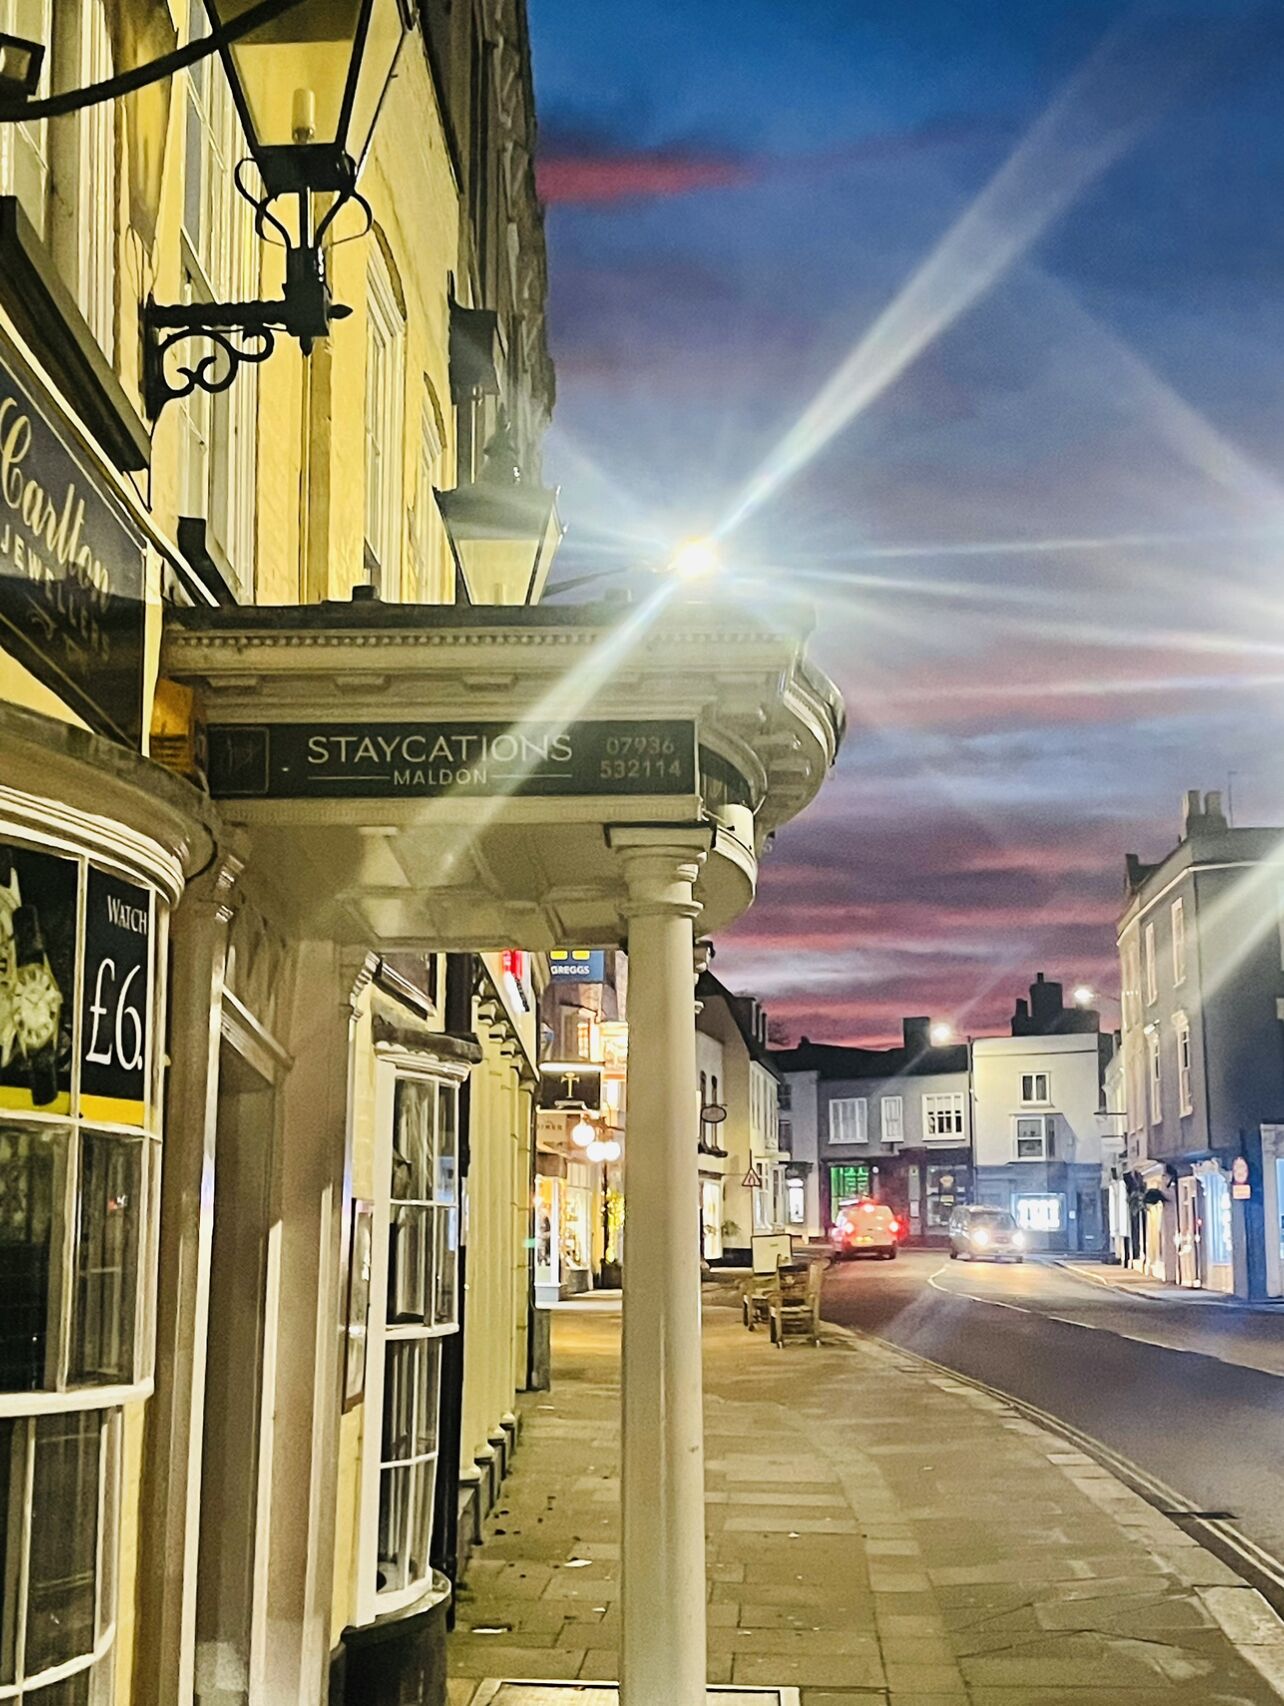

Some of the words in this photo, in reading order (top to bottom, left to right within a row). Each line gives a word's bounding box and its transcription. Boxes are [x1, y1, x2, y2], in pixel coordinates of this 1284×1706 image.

[0, 396, 109, 596] Carlton
[1, 524, 110, 664] JEWELLERS
[308, 735, 572, 763] STAYCATIONS
[606, 737, 674, 755] 07936
[393, 769, 487, 785] MALDON
[600, 760, 681, 778] 532114
